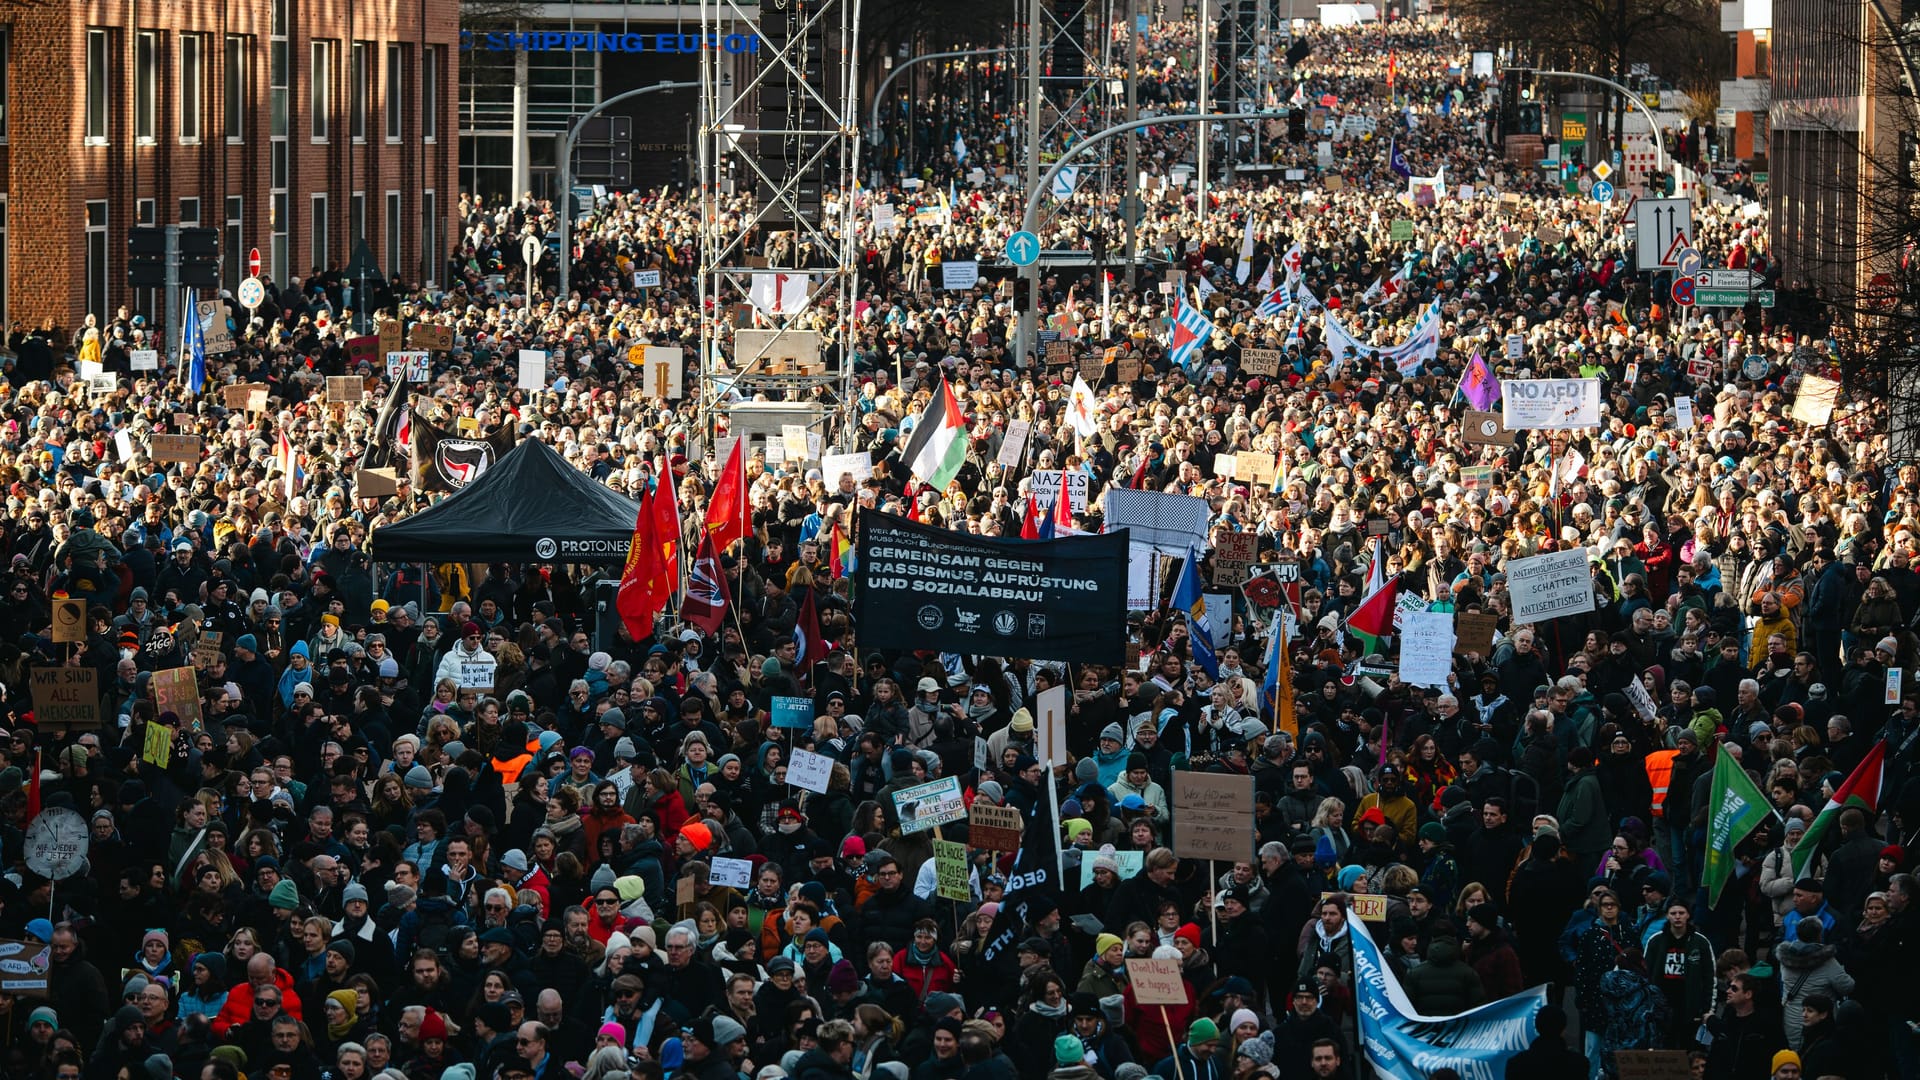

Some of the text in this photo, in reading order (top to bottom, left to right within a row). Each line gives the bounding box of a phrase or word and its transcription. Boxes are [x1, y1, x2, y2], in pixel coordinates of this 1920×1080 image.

[486, 32, 644, 54] SHIPPING
[1563, 126, 1587, 138] HALT
[1718, 294, 1750, 302] Steigenber
[1510, 383, 1539, 399] NO
[561, 540, 631, 552] PROTONES
[1220, 532, 1256, 545] STOPPT
[1218, 550, 1252, 560] RECHTE
[1233, 544, 1248, 552] DIE
[870, 546, 1044, 573] GEMEINSAM GEGEN
[1568, 556, 1584, 567] HASS
[870, 562, 1099, 592] RASSISMUS, AUFRÜSTUNG
[868, 577, 1044, 602] UND SOZIALABBAU!
[1532, 576, 1578, 594] SCHATTEN
[1406, 594, 1425, 609] STOP
[1520, 591, 1588, 615] ANTISEMITISMUS!
[35, 669, 92, 684] WIR SIND
[50, 688, 80, 703] ALLE
[40, 704, 96, 720] MENSCHEN
[923, 795, 942, 805] WIR
[918, 800, 962, 817] ALLE FÜR
[904, 811, 962, 832] DEMOKRATIE
[1352, 900, 1384, 916] EDER!
